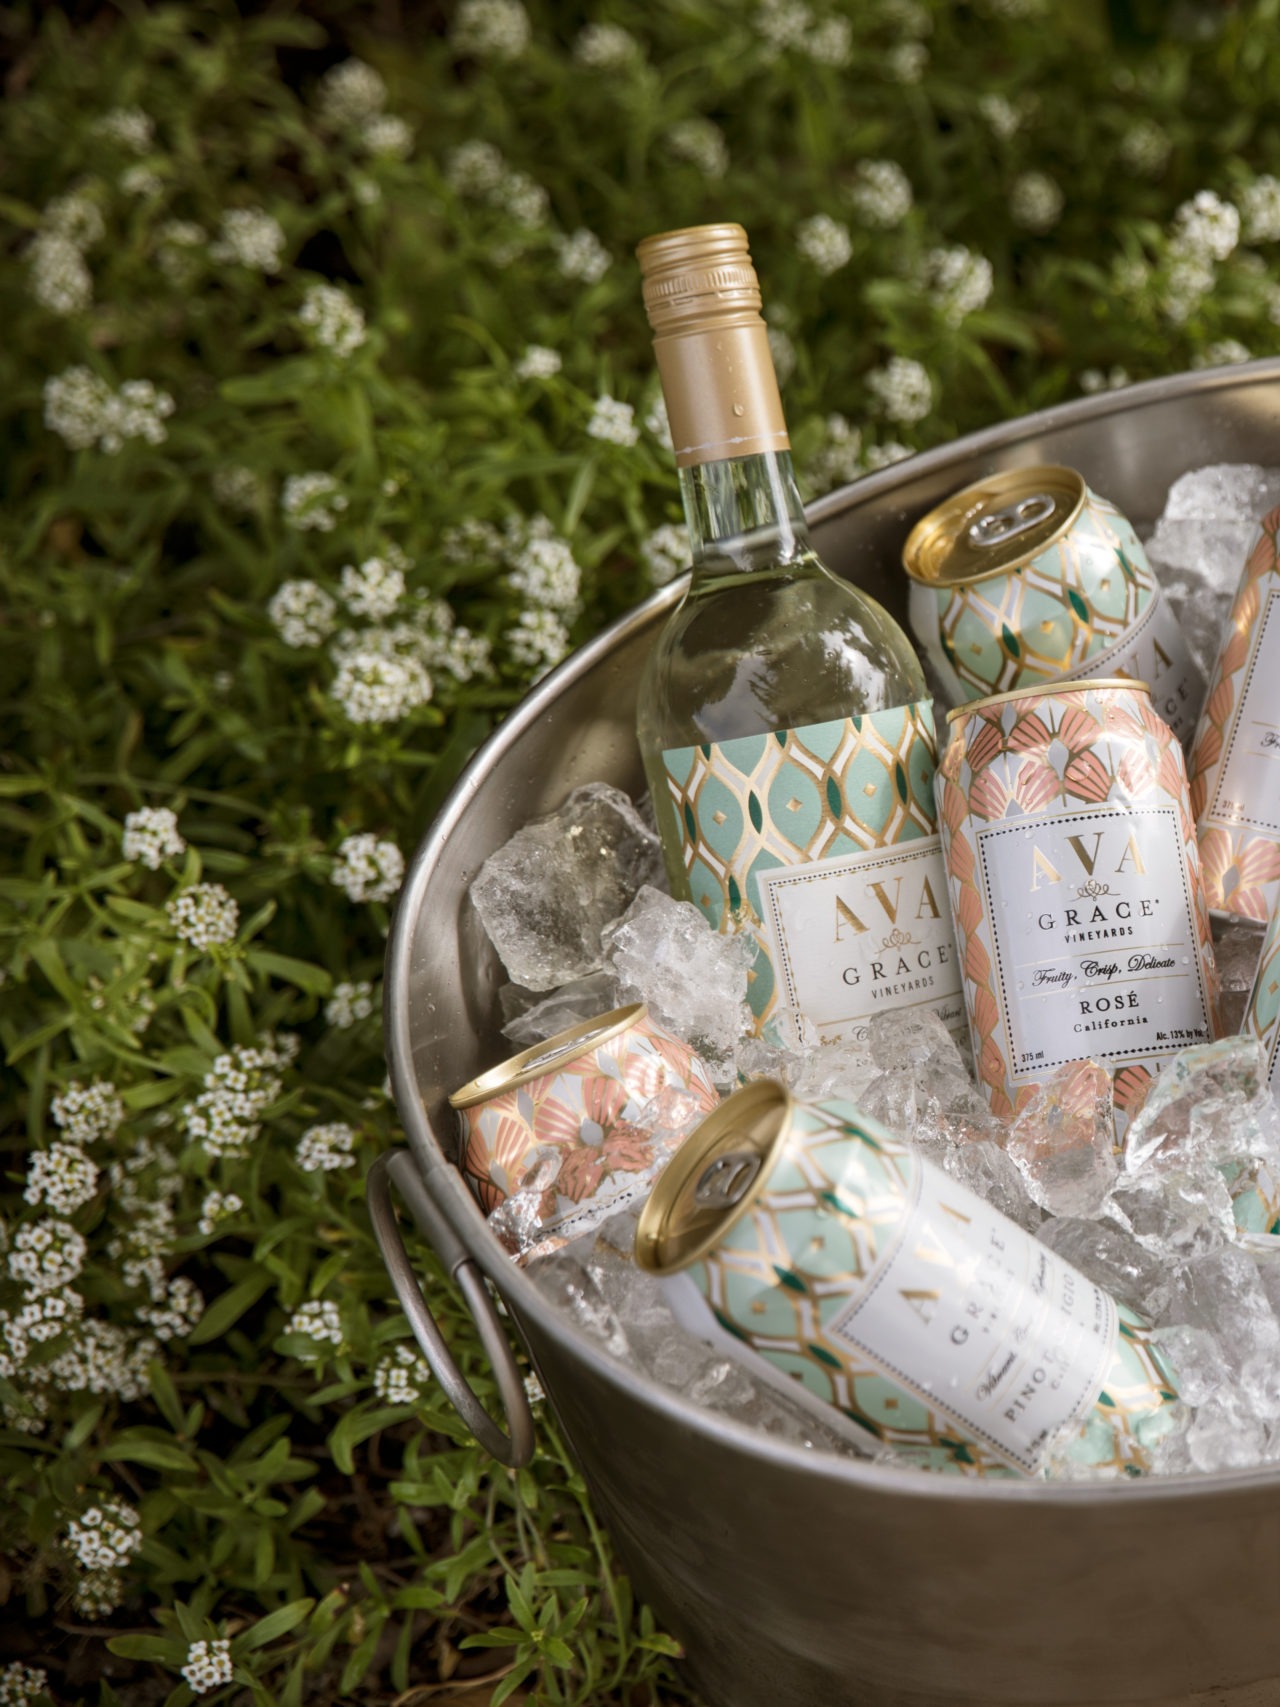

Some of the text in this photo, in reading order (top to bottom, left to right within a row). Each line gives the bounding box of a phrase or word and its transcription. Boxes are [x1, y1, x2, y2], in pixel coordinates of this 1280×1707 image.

[1029, 832, 1148, 893] AVA
[834, 874, 942, 943] AVA
[1038, 900, 1154, 931] GRACE
[1064, 926, 1134, 943] VINEYARDS
[842, 949, 950, 986] GRACE
[1032, 954, 1176, 989] Fruity, Crisp, Delicate
[872, 975, 935, 1000] VINEYARDS
[1080, 991, 1140, 1014] ROSÉ
[1073, 1016, 1149, 1033] California
[1170, 1030, 1185, 1040] 13%
[1186, 1029, 1193, 1040] by
[1021, 1050, 1045, 1063] 375 ml
